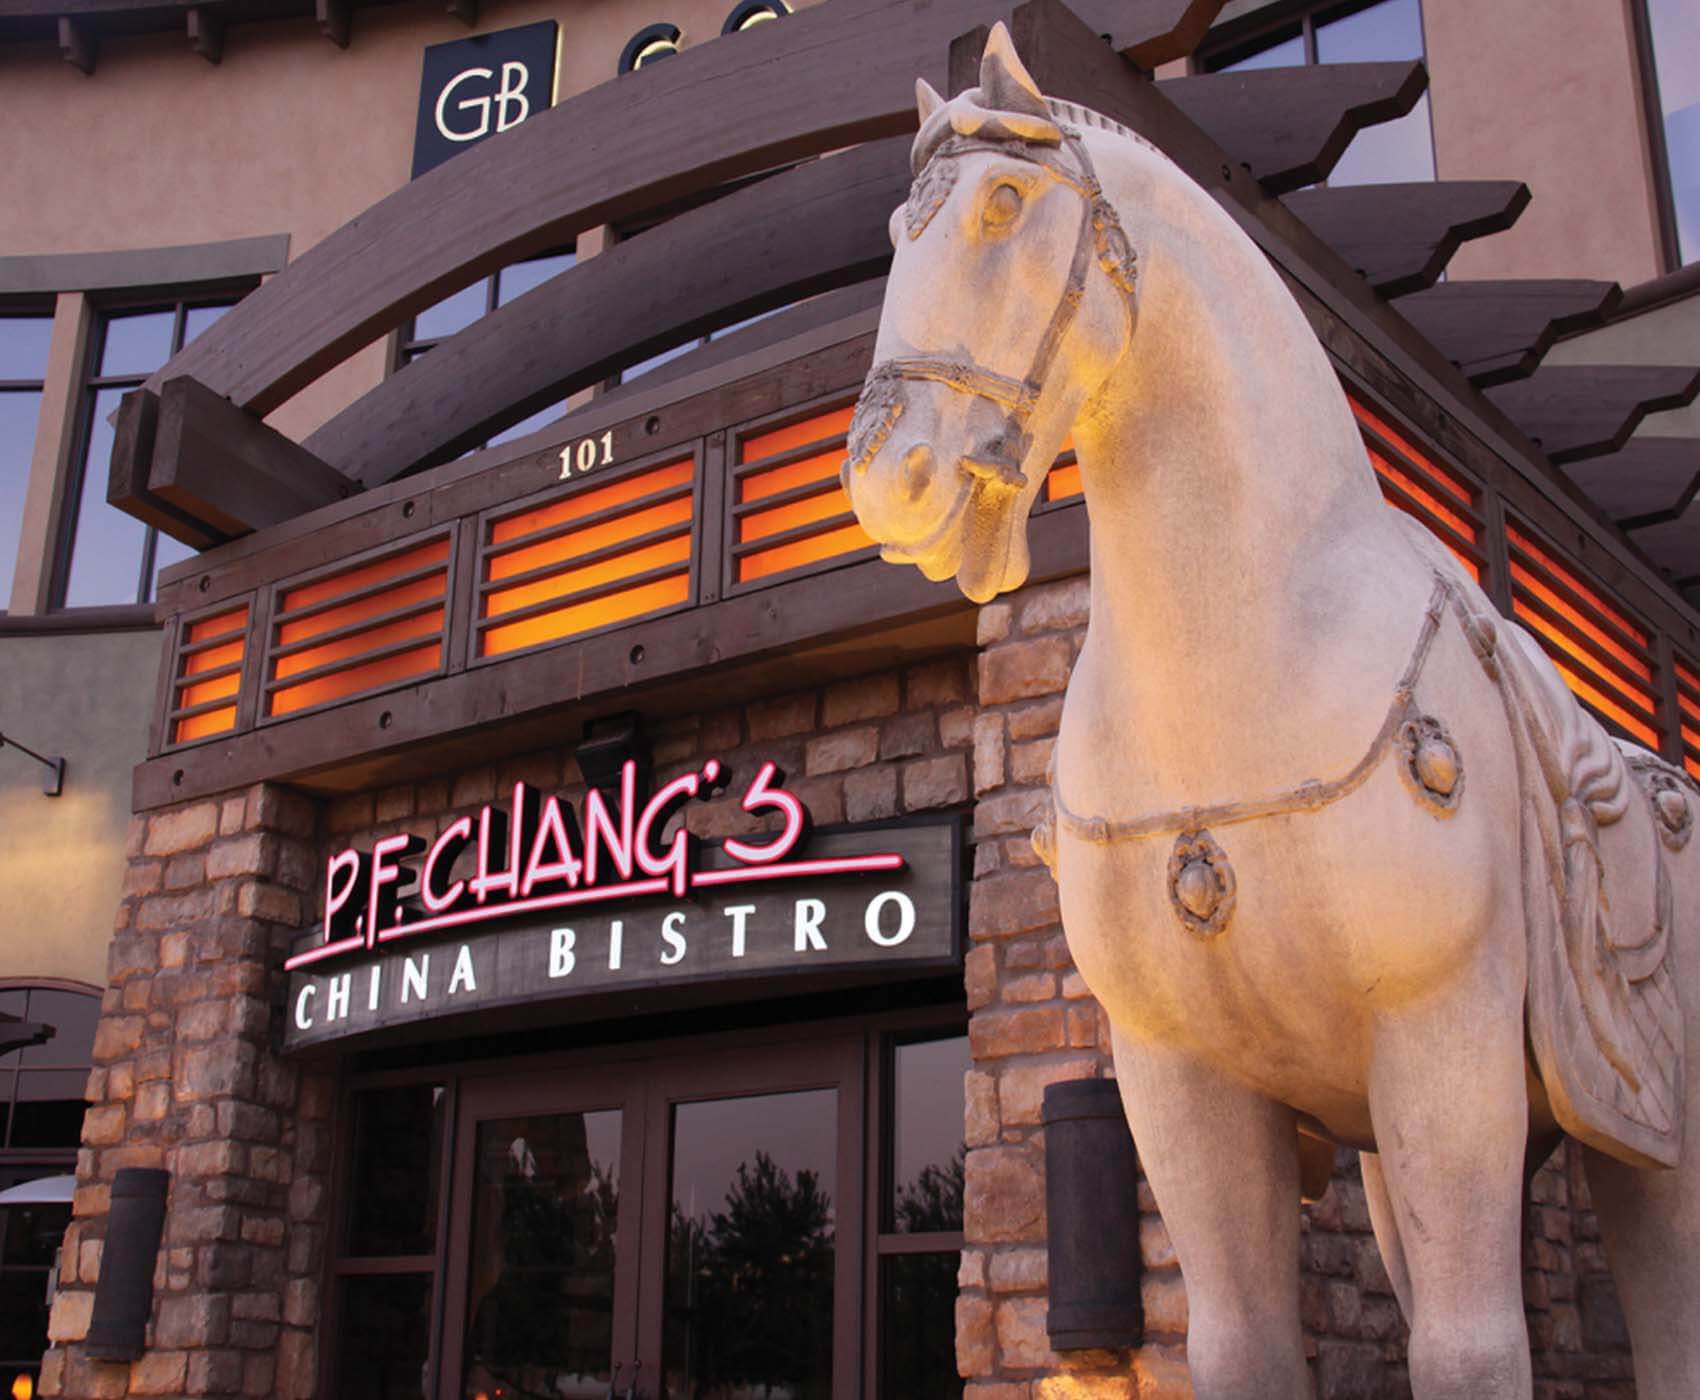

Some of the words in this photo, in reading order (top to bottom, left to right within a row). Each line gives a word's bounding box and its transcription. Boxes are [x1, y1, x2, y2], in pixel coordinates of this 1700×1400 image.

[434, 61, 529, 142] GB
[558, 430, 614, 480] 101
[294, 945, 477, 1030] CHINA
[548, 890, 916, 978] BISTRO
